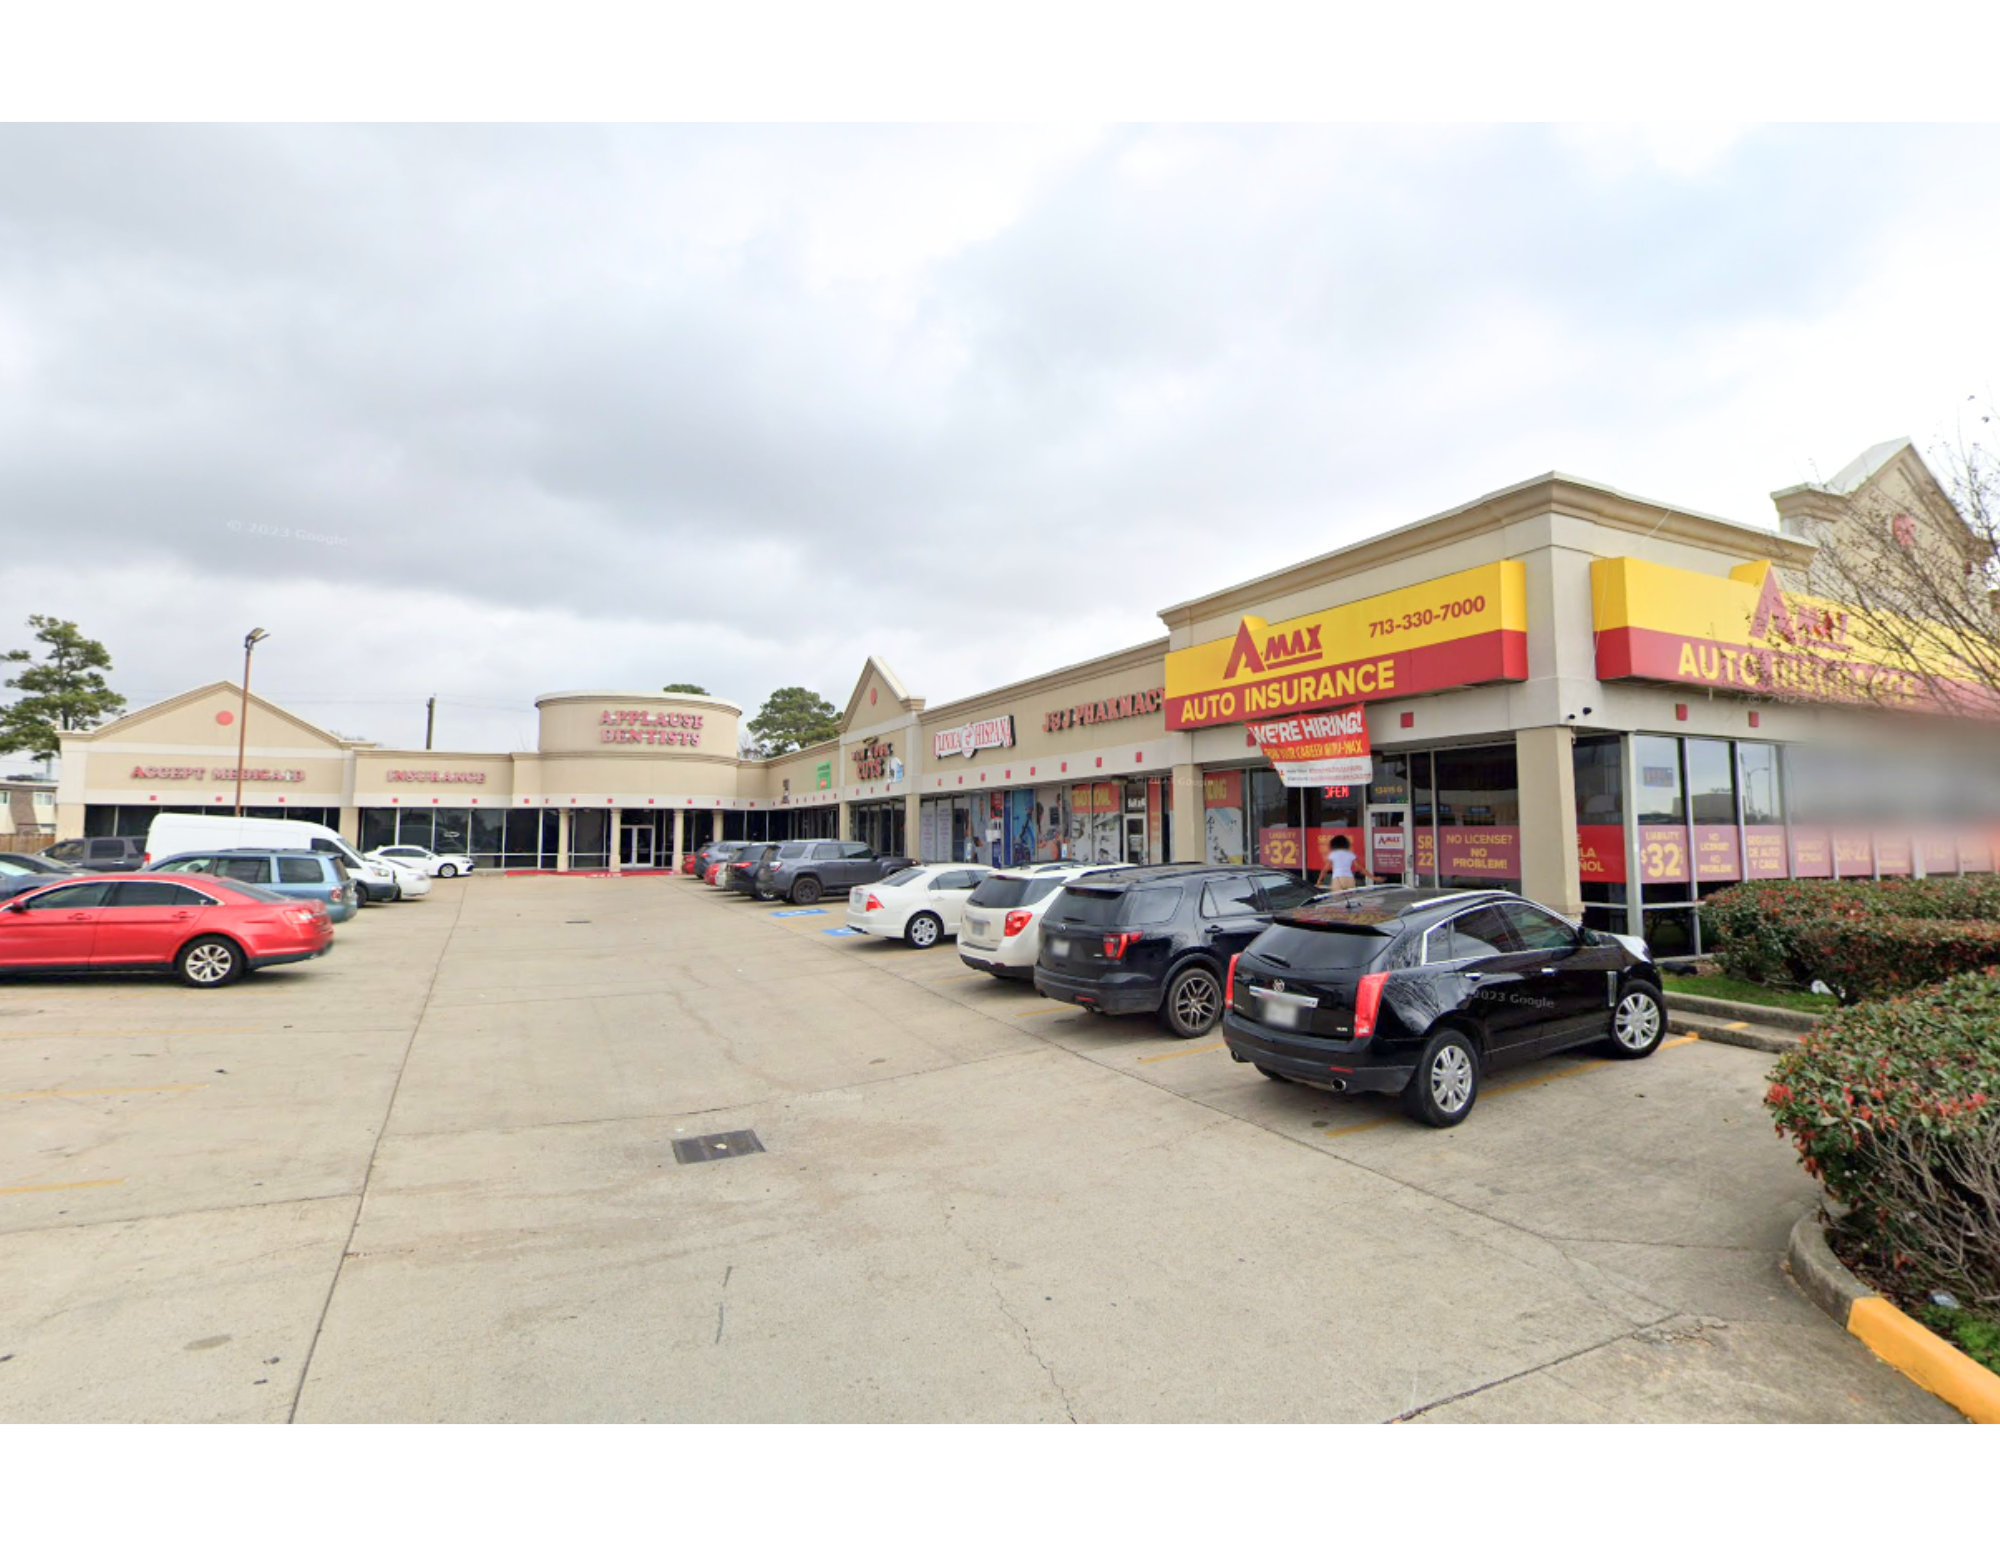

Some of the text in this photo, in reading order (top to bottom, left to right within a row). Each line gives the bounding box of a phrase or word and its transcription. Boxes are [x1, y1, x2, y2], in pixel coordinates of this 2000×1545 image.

[1369, 595, 1486, 638] 713-330-7000
[1678, 642, 1761, 686] AUTO
[1181, 659, 1395, 723] AUTO INSURANCE
[599, 710, 704, 729] APPLAUSE
[1250, 710, 1363, 744] WE'RE HIRING!
[601, 728, 702, 747] DENTISTS
[975, 718, 1011, 747] HISPANA
[130, 766, 206, 781] ACCEPT
[386, 770, 486, 785] INSURANCE
[1446, 834, 1513, 845] NO LICENSE?
[1264, 839, 1297, 865] $32
[1470, 847, 1487, 858] NO
[1580, 847, 1597, 858] LA
[1640, 842, 1682, 878] $32
[1452, 857, 1508, 870] PROBLEM!
[1579, 858, 1605, 872] ÑOL
